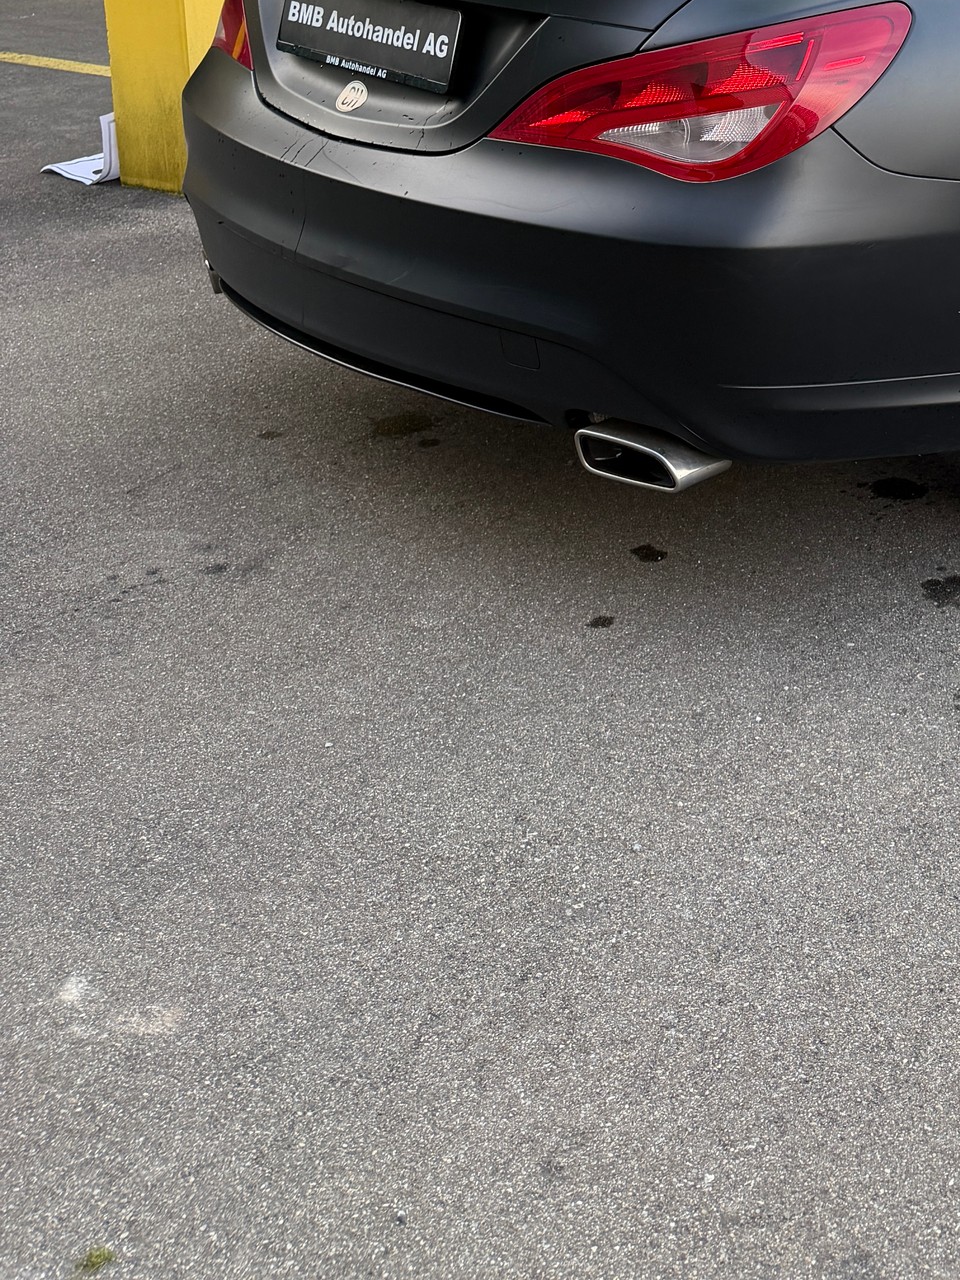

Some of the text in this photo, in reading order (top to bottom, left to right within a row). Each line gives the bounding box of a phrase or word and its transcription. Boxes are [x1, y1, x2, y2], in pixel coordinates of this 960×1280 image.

[287, 0, 449, 58] BMB Autohandel AG
[325, 55, 388, 79] BMB Autohandel AG
